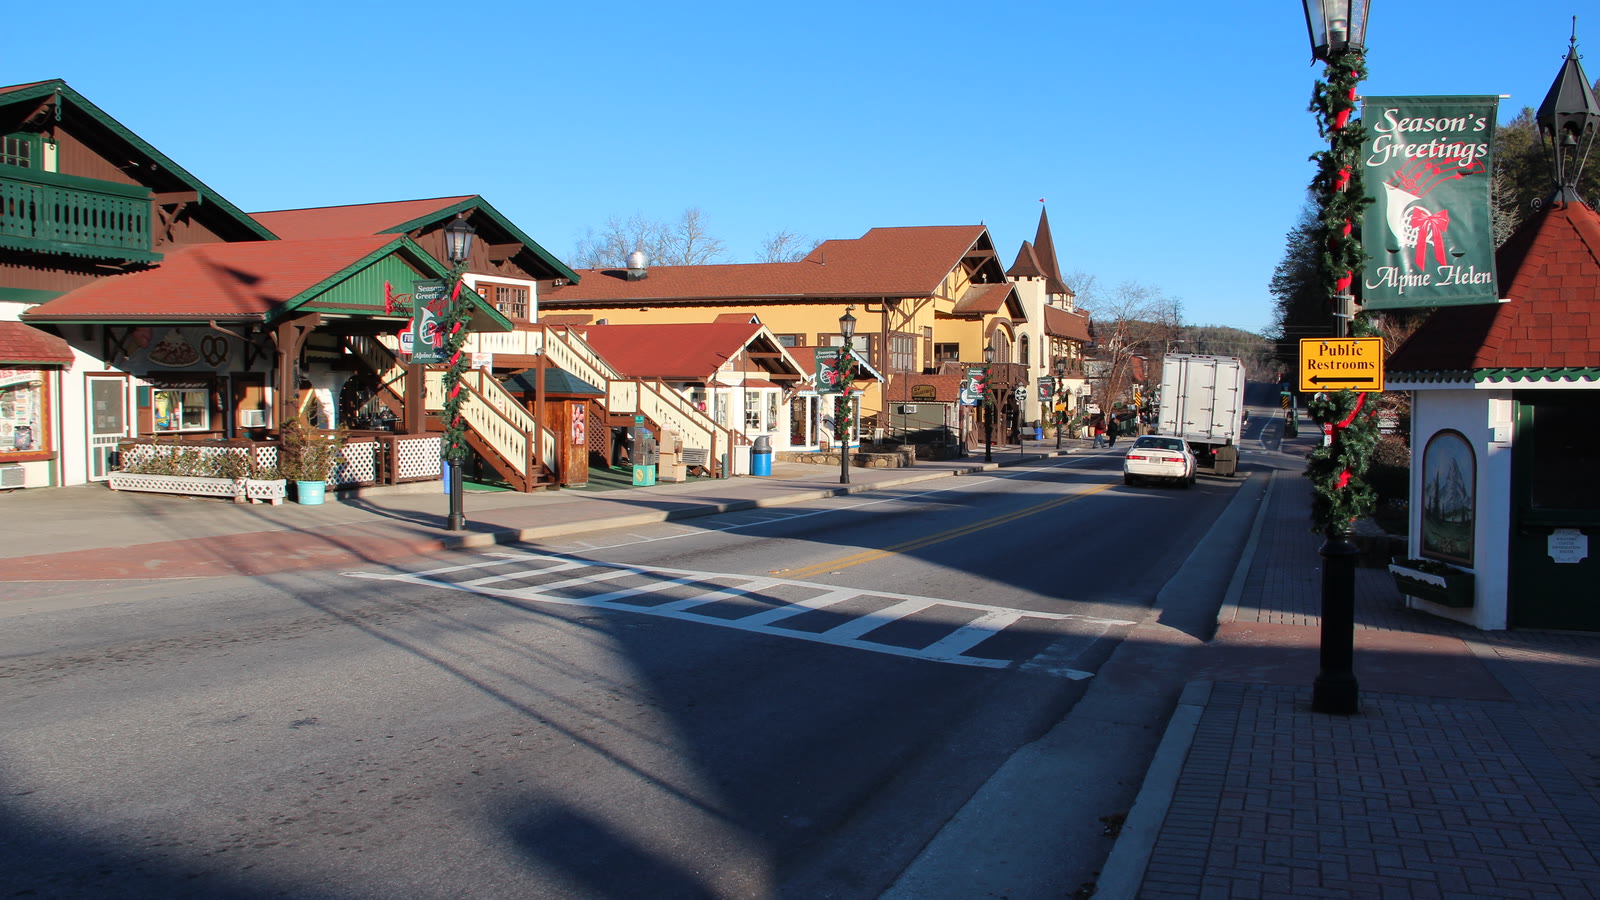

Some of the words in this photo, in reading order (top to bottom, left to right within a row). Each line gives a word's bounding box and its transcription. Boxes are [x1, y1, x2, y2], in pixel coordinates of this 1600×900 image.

[1374, 108, 1487, 132] Season's
[1366, 134, 1488, 167] Greetings
[1365, 266, 1431, 295] Alpine
[1435, 265, 1492, 286] Helen
[1319, 344, 1363, 356] Public
[1308, 359, 1375, 370] Restrooms
